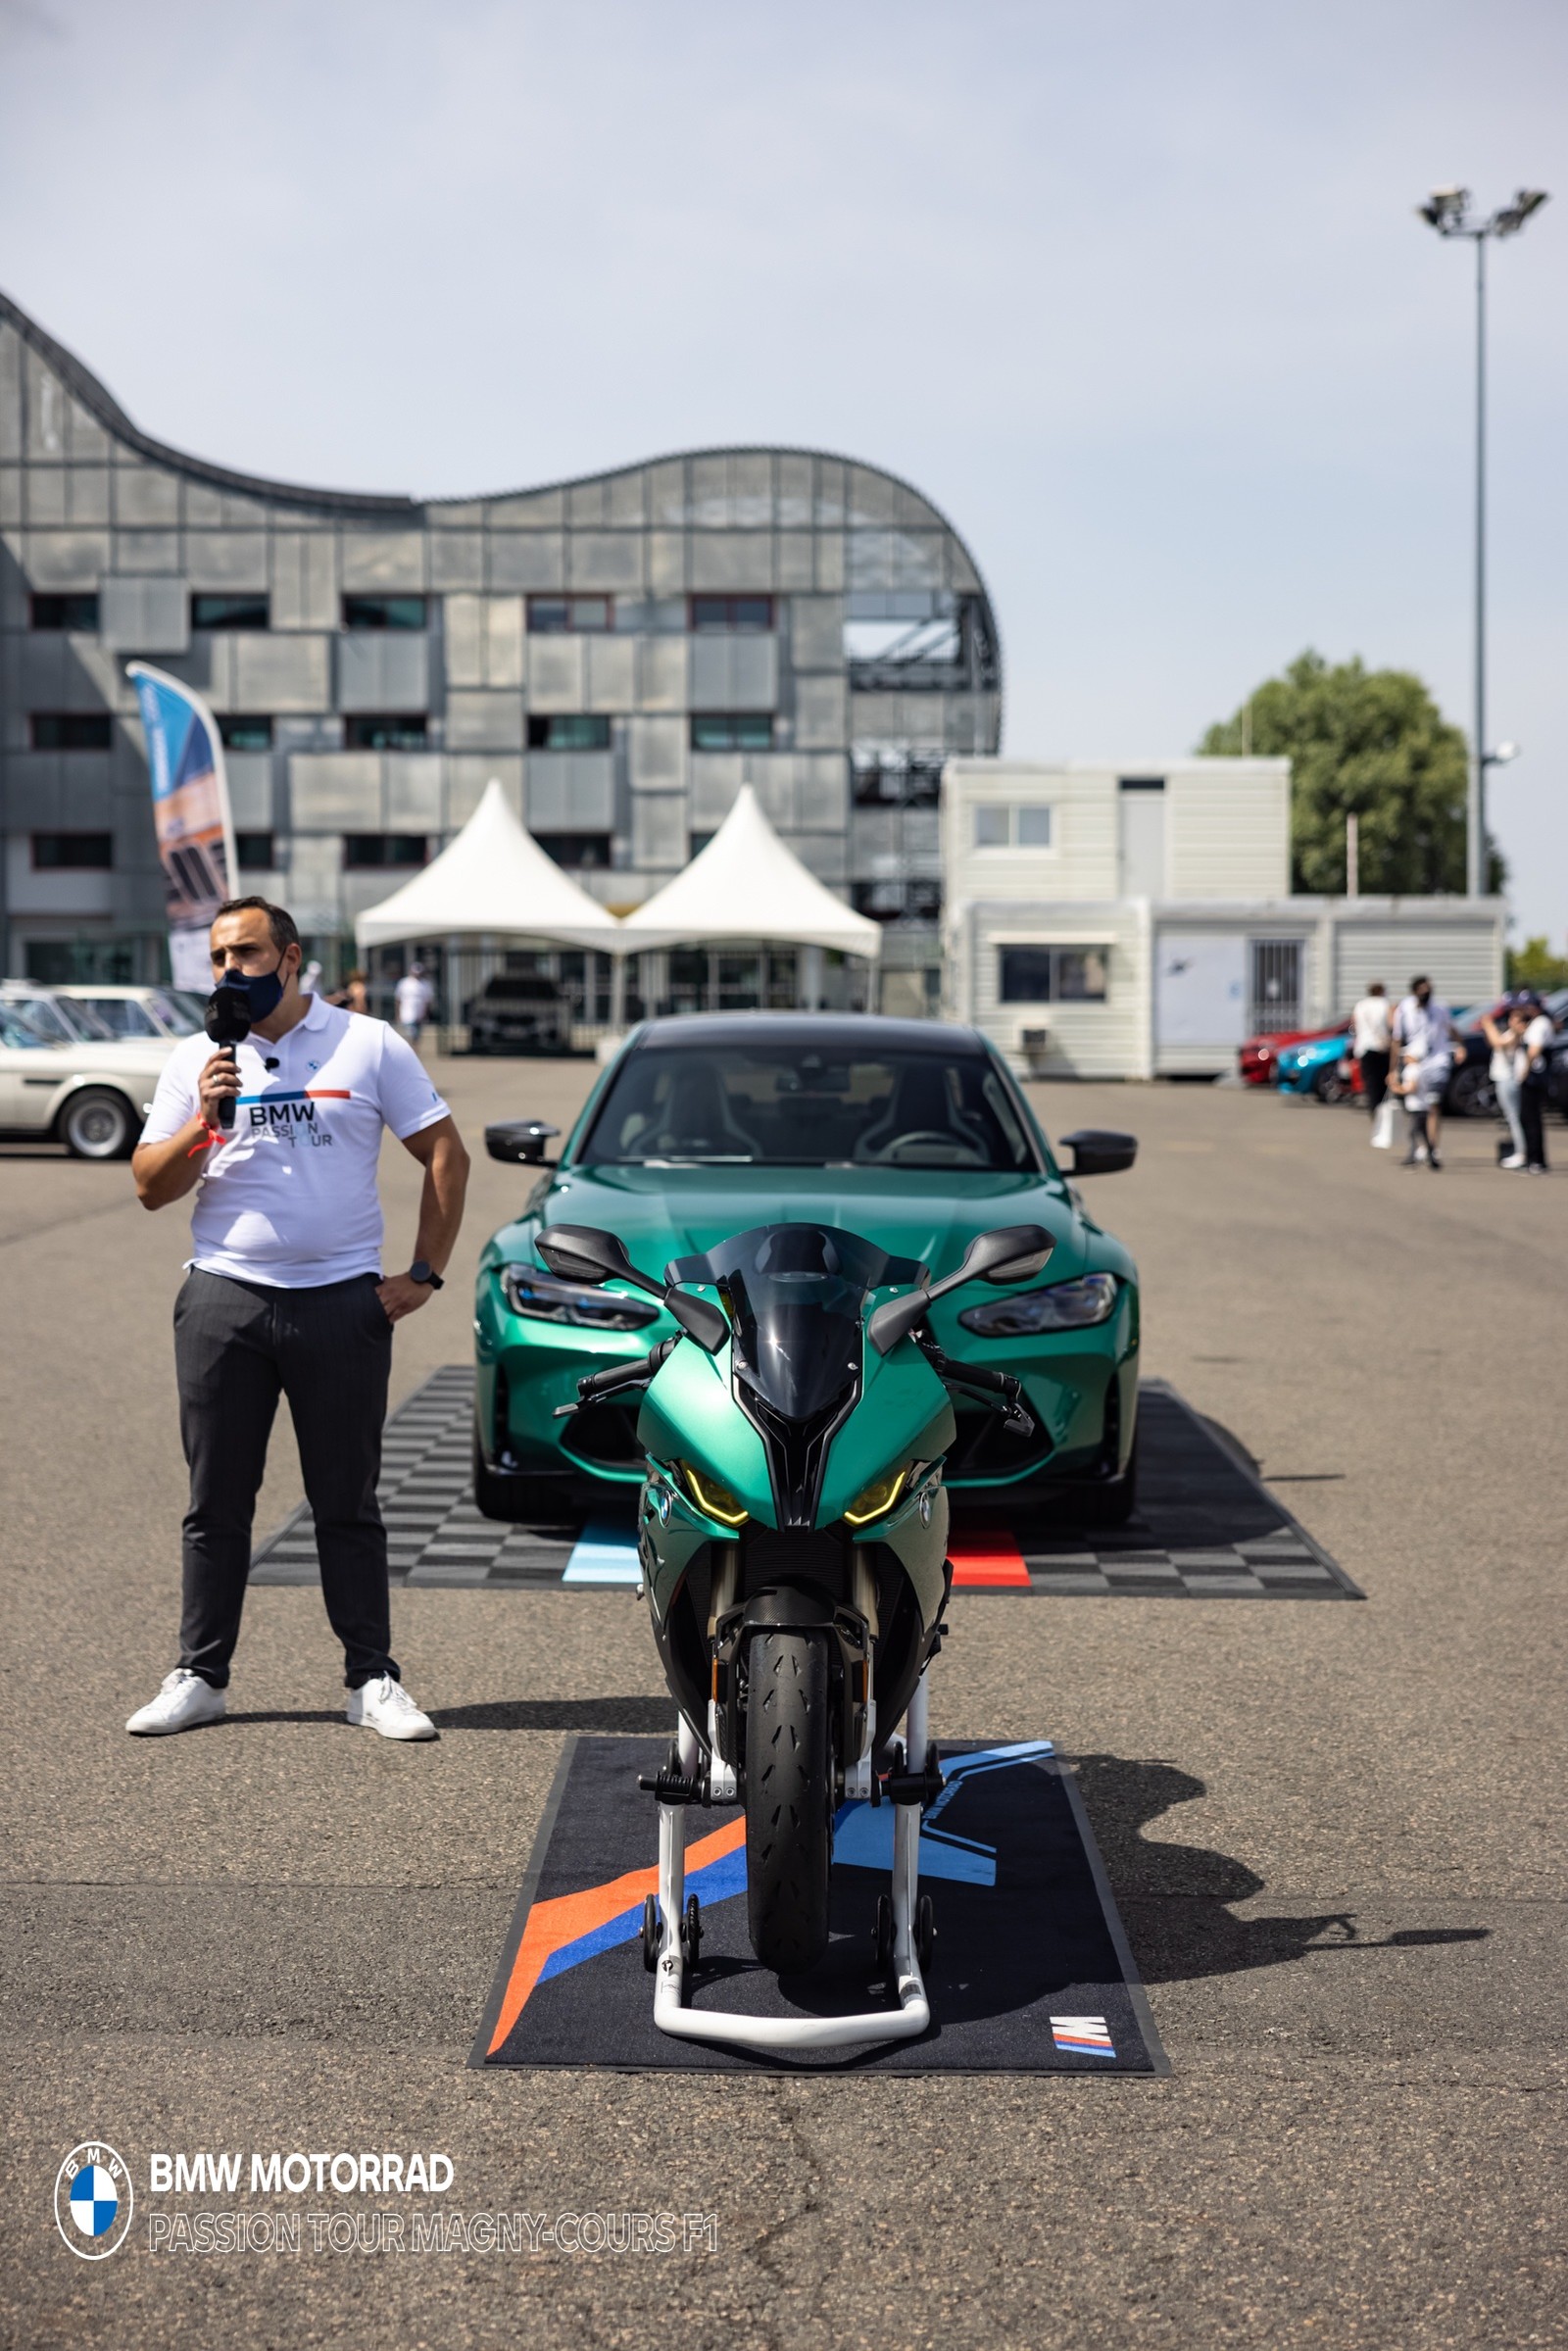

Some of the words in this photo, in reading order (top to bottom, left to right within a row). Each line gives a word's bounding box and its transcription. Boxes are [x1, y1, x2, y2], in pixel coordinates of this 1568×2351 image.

[250, 1102, 315, 1127] BMW
[252, 1122, 318, 1139] PASSION
[288, 1134, 332, 1148] TOUR
